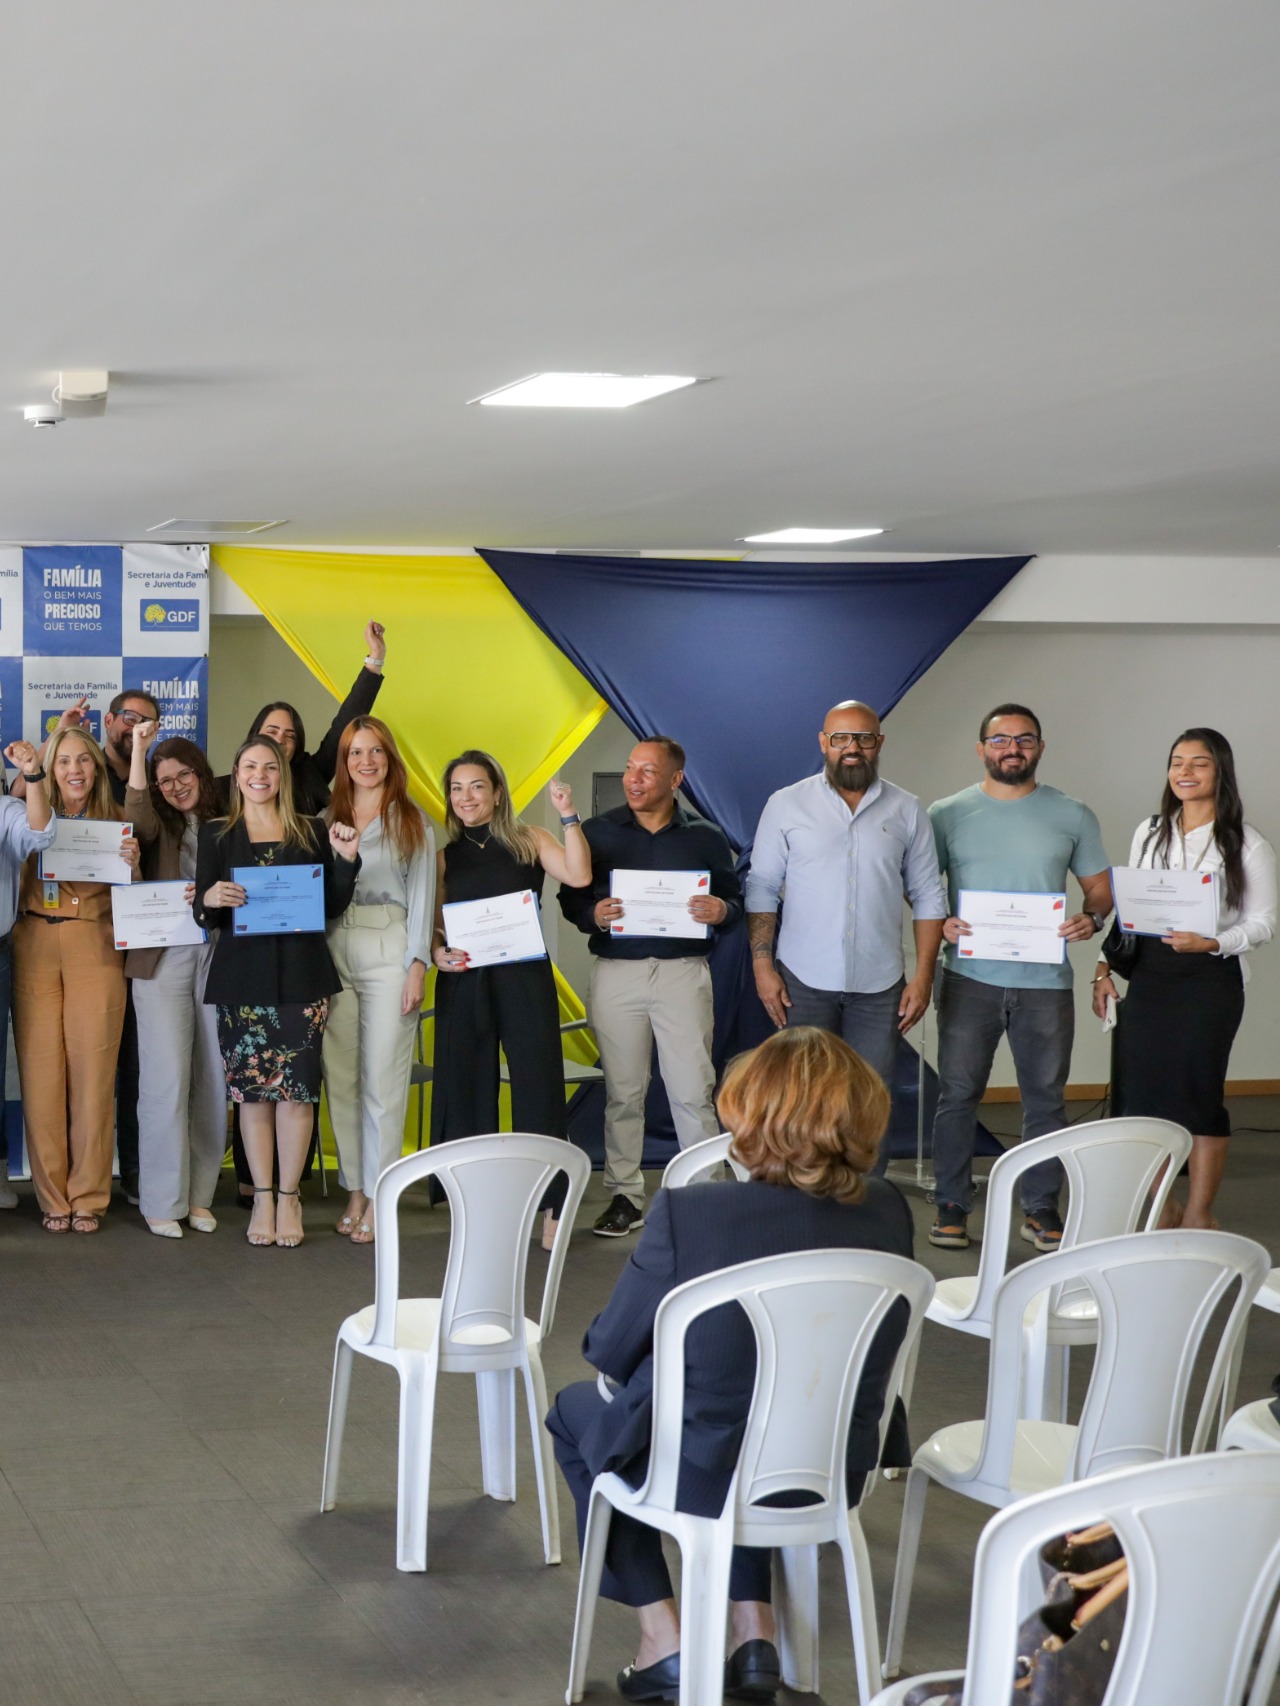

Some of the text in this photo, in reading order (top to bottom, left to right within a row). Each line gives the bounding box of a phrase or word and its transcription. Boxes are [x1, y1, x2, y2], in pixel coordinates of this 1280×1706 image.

[44, 565, 102, 587] FAMÍLIA
[45, 603, 100, 619] PRECIOSO
[167, 611, 196, 622] GDF
[44, 622, 102, 631] QUE TEMOS
[143, 676, 199, 698] FAMÍLIA
[159, 714, 197, 730] ECIOSO
